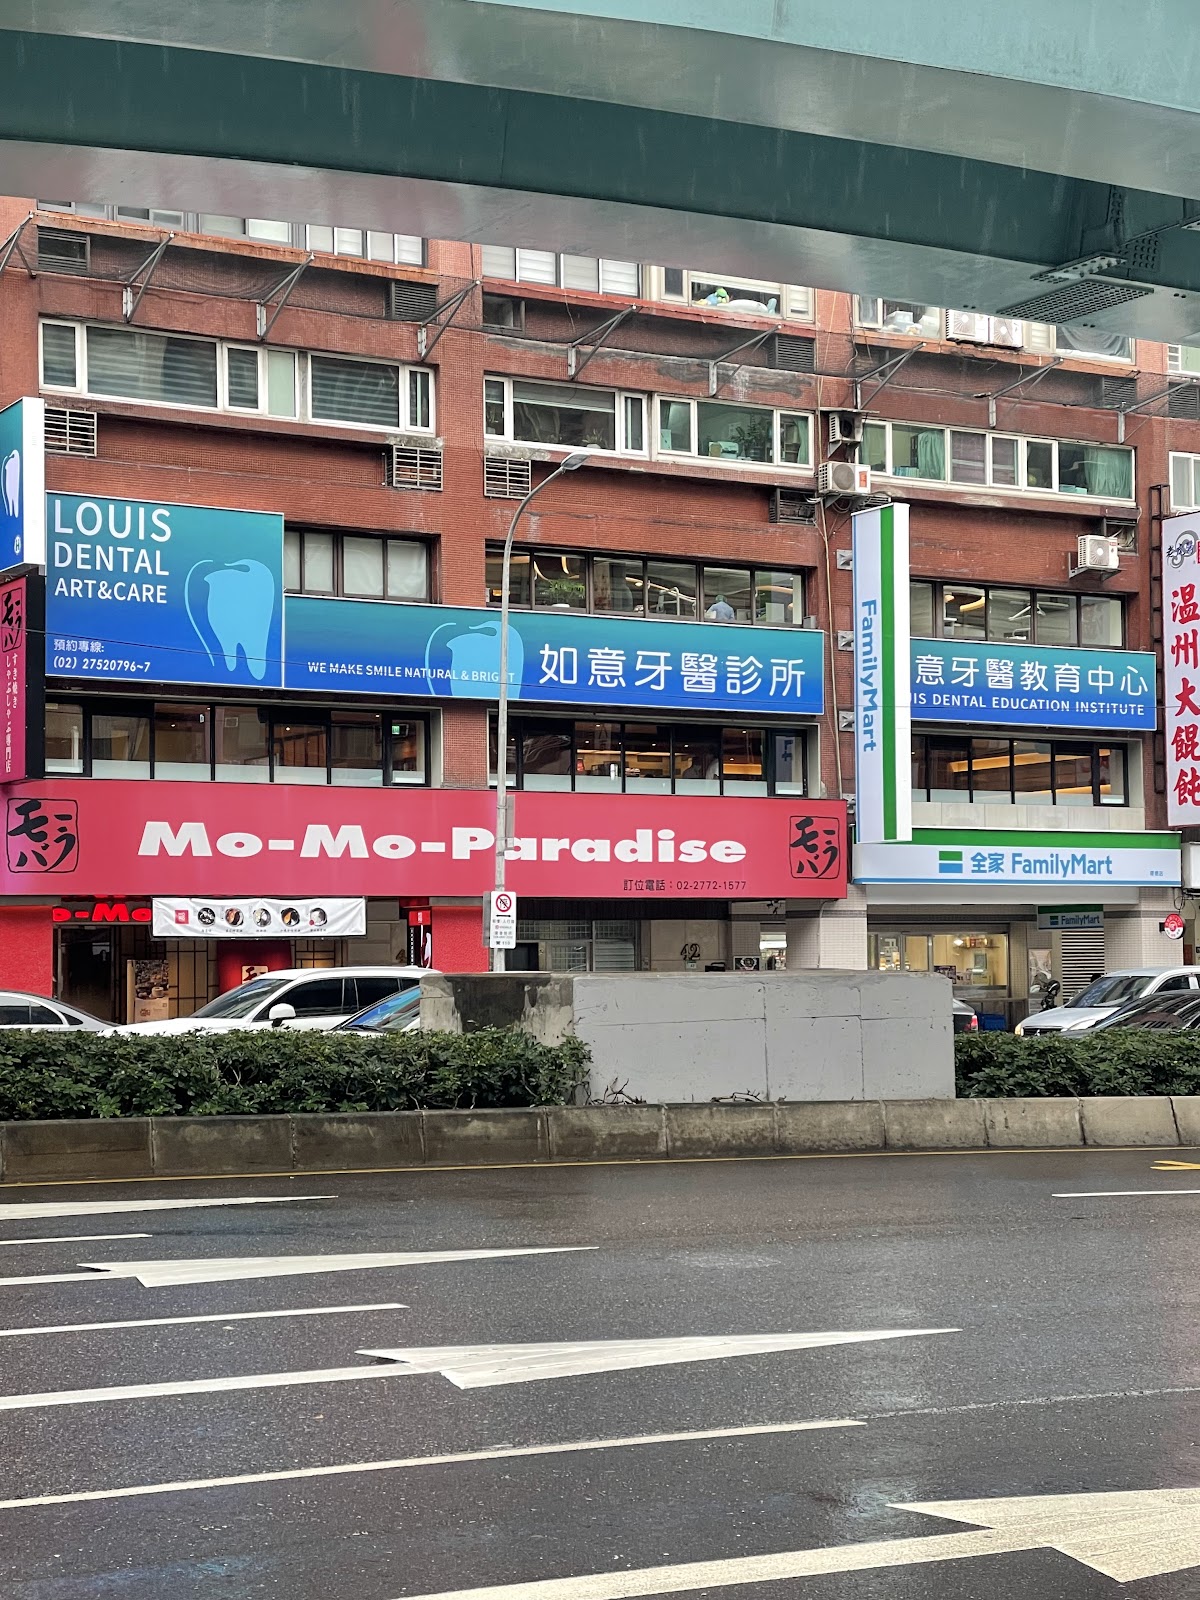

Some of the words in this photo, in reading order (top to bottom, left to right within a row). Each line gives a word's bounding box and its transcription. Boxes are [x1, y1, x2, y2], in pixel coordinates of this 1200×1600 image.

[54, 499, 172, 542] LOUIS
[54, 542, 170, 576] DENTAL
[54, 577, 168, 604] ART&CARE
[53, 656, 77, 670] (02)
[82, 658, 151, 673] 27520796~7
[308, 661, 327, 673] WE
[330, 662, 363, 675] MAKE
[366, 664, 402, 677] SMILE
[405, 667, 459, 681] NATURAL
[460, 670, 470, 681] &
[472, 671, 515, 683] BRIGT
[538, 643, 806, 698] 如意牙醫診所
[859, 599, 877, 753] FamilyMart
[915, 653, 1149, 697] 意牙醫教育中心
[910, 691, 927, 705] IS
[932, 693, 987, 708] DENTAL
[992, 696, 1070, 713] EDUCATION
[1075, 700, 1145, 716] INSTITUTE
[138, 821, 747, 864] Mo-Mo-Paradise
[970, 852, 1005, 874] 全家
[1012, 852, 1113, 879] FamilyMart
[676, 880, 747, 891] 02-2772-1577
[1061, 914, 1100, 926] FamilyMart
[681, 943, 701, 960] 42
